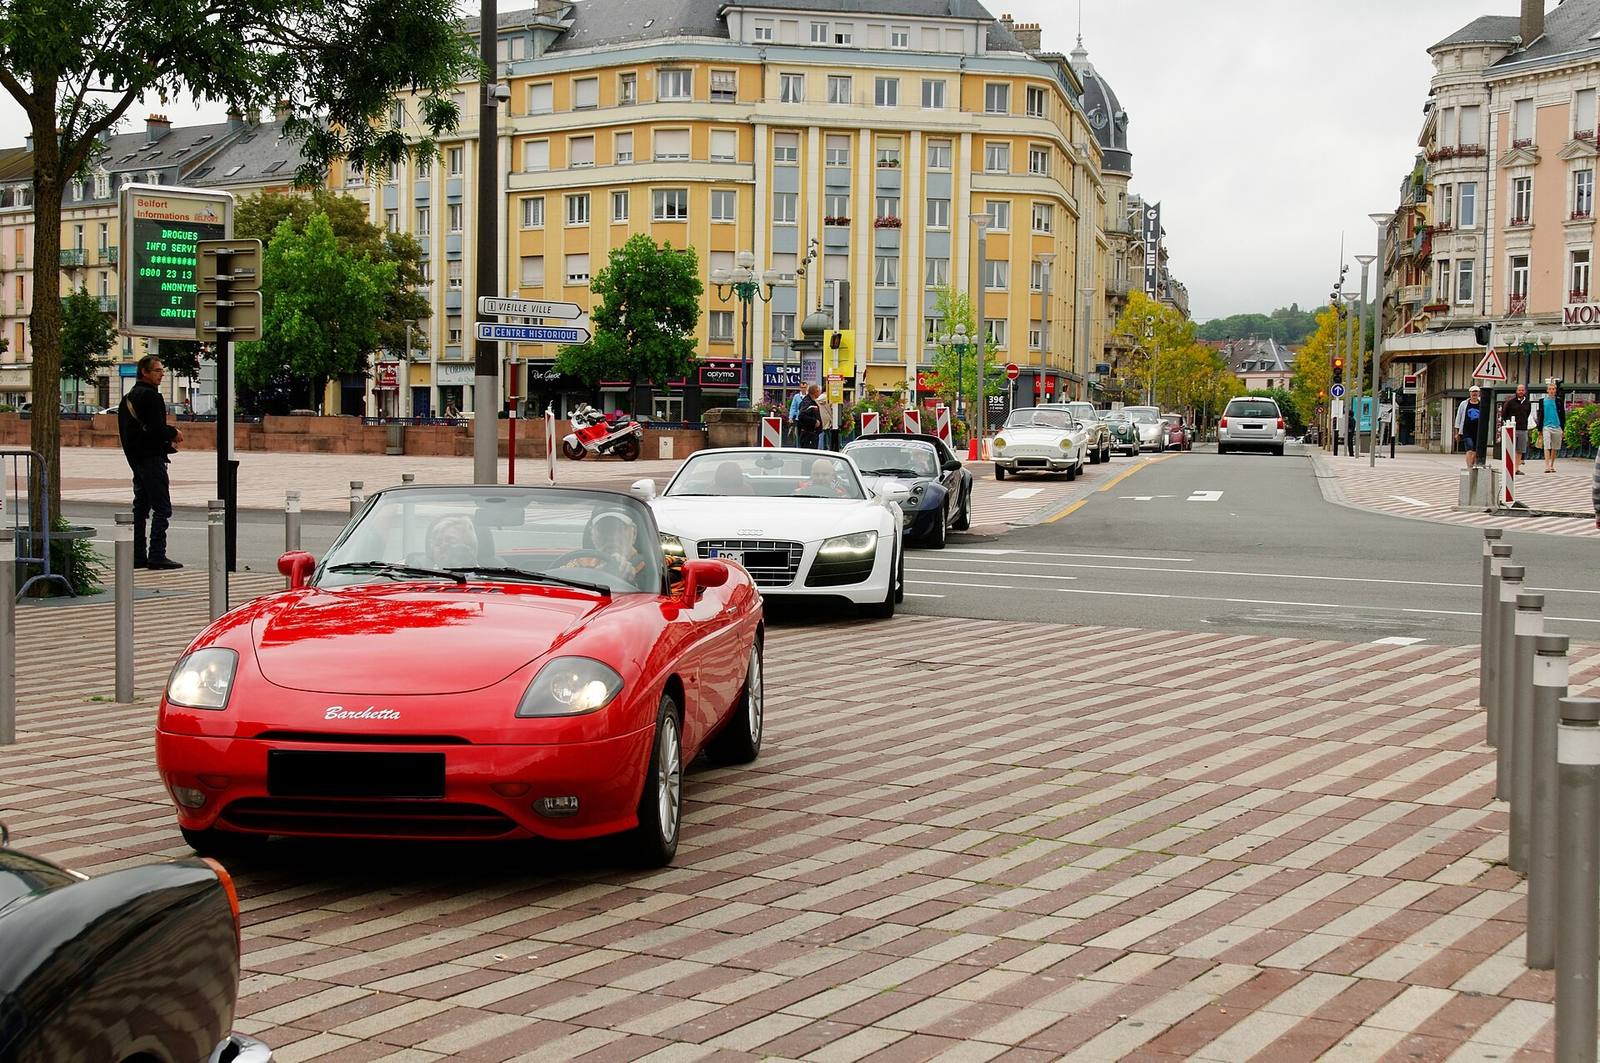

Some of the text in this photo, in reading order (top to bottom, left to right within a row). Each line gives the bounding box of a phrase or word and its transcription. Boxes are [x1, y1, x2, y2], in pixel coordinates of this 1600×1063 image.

[137, 199, 168, 209] Belfort
[137, 210, 190, 221] Informations
[162, 229, 198, 241] DROGUES
[146, 241, 167, 251] INFO
[1146, 209, 1157, 276] GILLET
[140, 268, 192, 279] 0800 23 13
[161, 282, 197, 293] ANONYME
[171, 296, 182, 304] ET
[160, 308, 197, 319] GRATUIT
[499, 303, 527, 312] VIEILLE
[531, 304, 552, 314] VILLE
[495, 327, 526, 337] CENTRE
[529, 329, 577, 340] HISTORIQUE
[989, 395, 1004, 403] 39€
[324, 705, 401, 720] Barchetta
